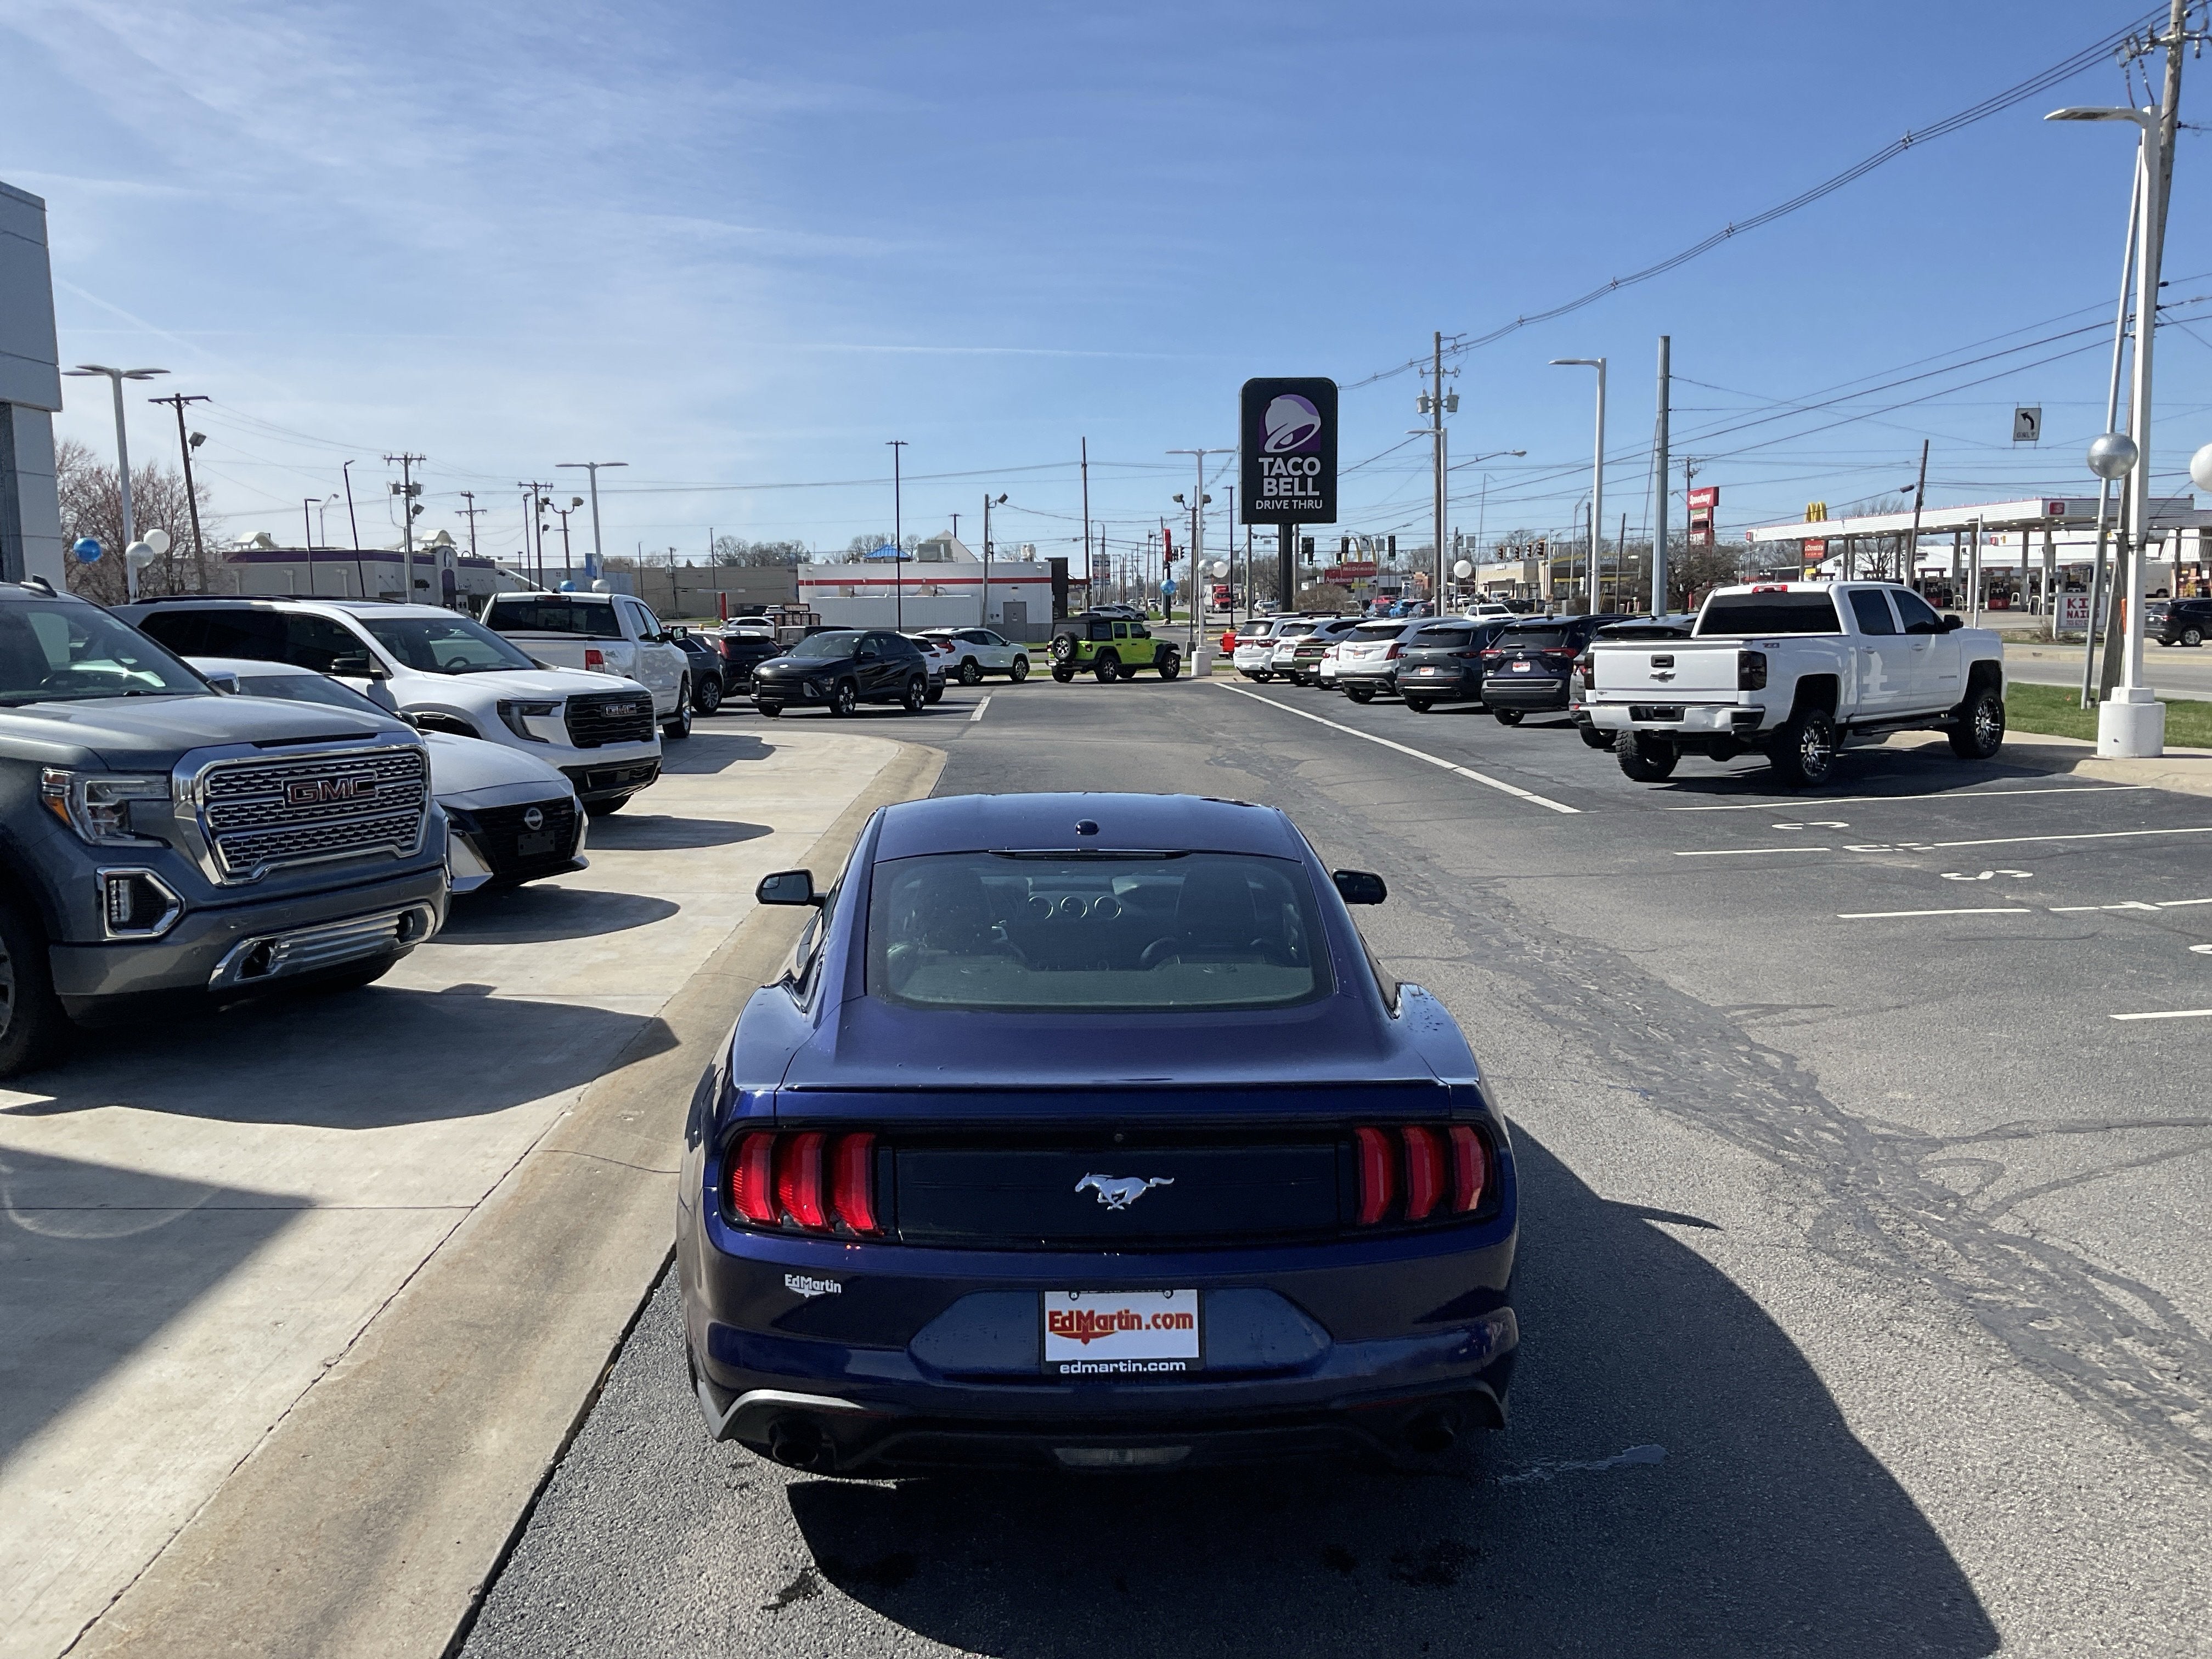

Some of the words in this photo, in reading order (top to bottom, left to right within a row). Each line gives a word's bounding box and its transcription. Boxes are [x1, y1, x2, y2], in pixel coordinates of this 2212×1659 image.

[1259, 457, 1321, 476] TACO
[1263, 477, 1320, 496] BELL
[1256, 500, 1289, 510] DRIVE
[1292, 499, 1323, 509] THRU
[606, 704, 636, 715] GMC
[287, 775, 376, 804] GMC
[785, 1274, 842, 1294] EdMartin
[1059, 1360, 1186, 1374] edmartin.com
